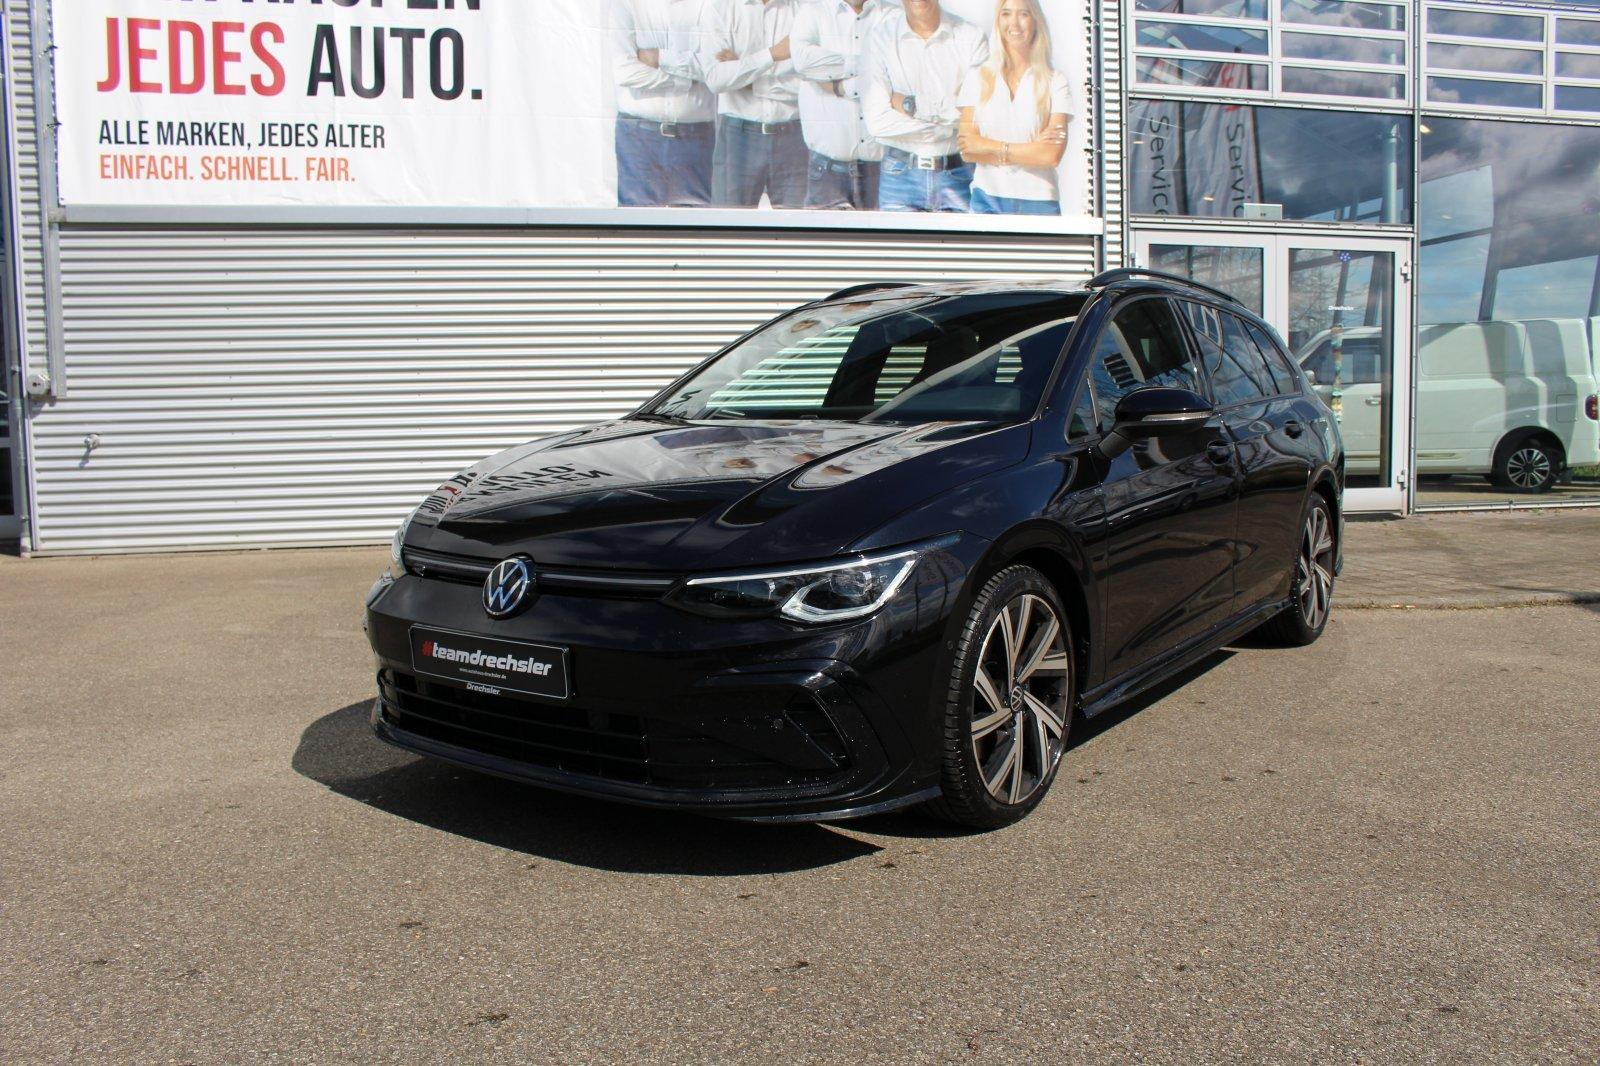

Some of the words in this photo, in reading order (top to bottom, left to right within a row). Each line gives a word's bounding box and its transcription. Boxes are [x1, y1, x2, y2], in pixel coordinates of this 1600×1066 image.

[96, 17, 286, 97] JEDES
[306, 24, 483, 101] AUTO.
[98, 119, 150, 146] ALLE
[156, 121, 252, 151] MARKEN,
[257, 122, 319, 148] JEDES
[324, 123, 385, 149] ALTER
[99, 154, 194, 181] EINFACH.
[200, 156, 299, 182] SCHNELL.
[305, 157, 356, 182] FAIR.
[421, 640, 553, 676] #teamdrechsler
